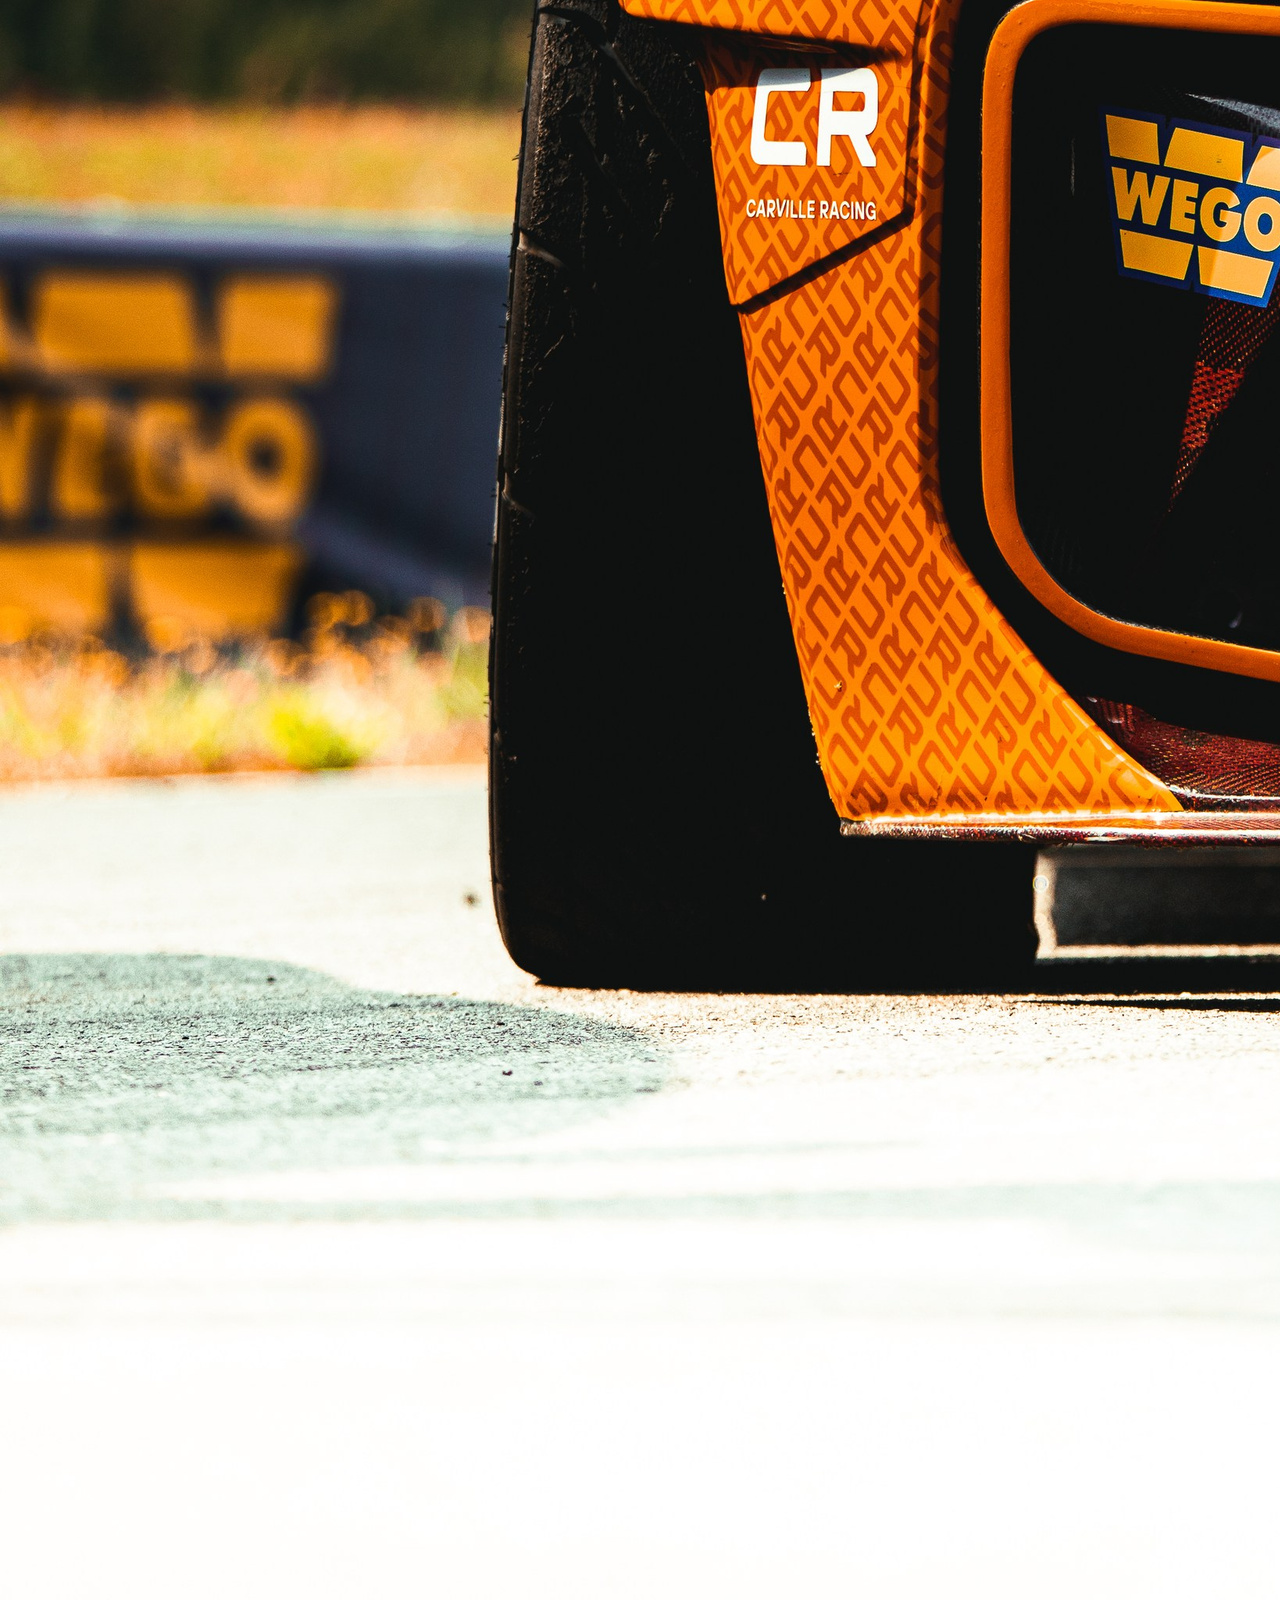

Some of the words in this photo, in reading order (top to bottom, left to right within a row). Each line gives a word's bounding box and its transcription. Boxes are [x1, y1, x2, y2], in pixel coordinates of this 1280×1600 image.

[750, 67, 878, 167] CR
[746, 198, 816, 220] CARVILLE
[819, 201, 877, 221] RACING
